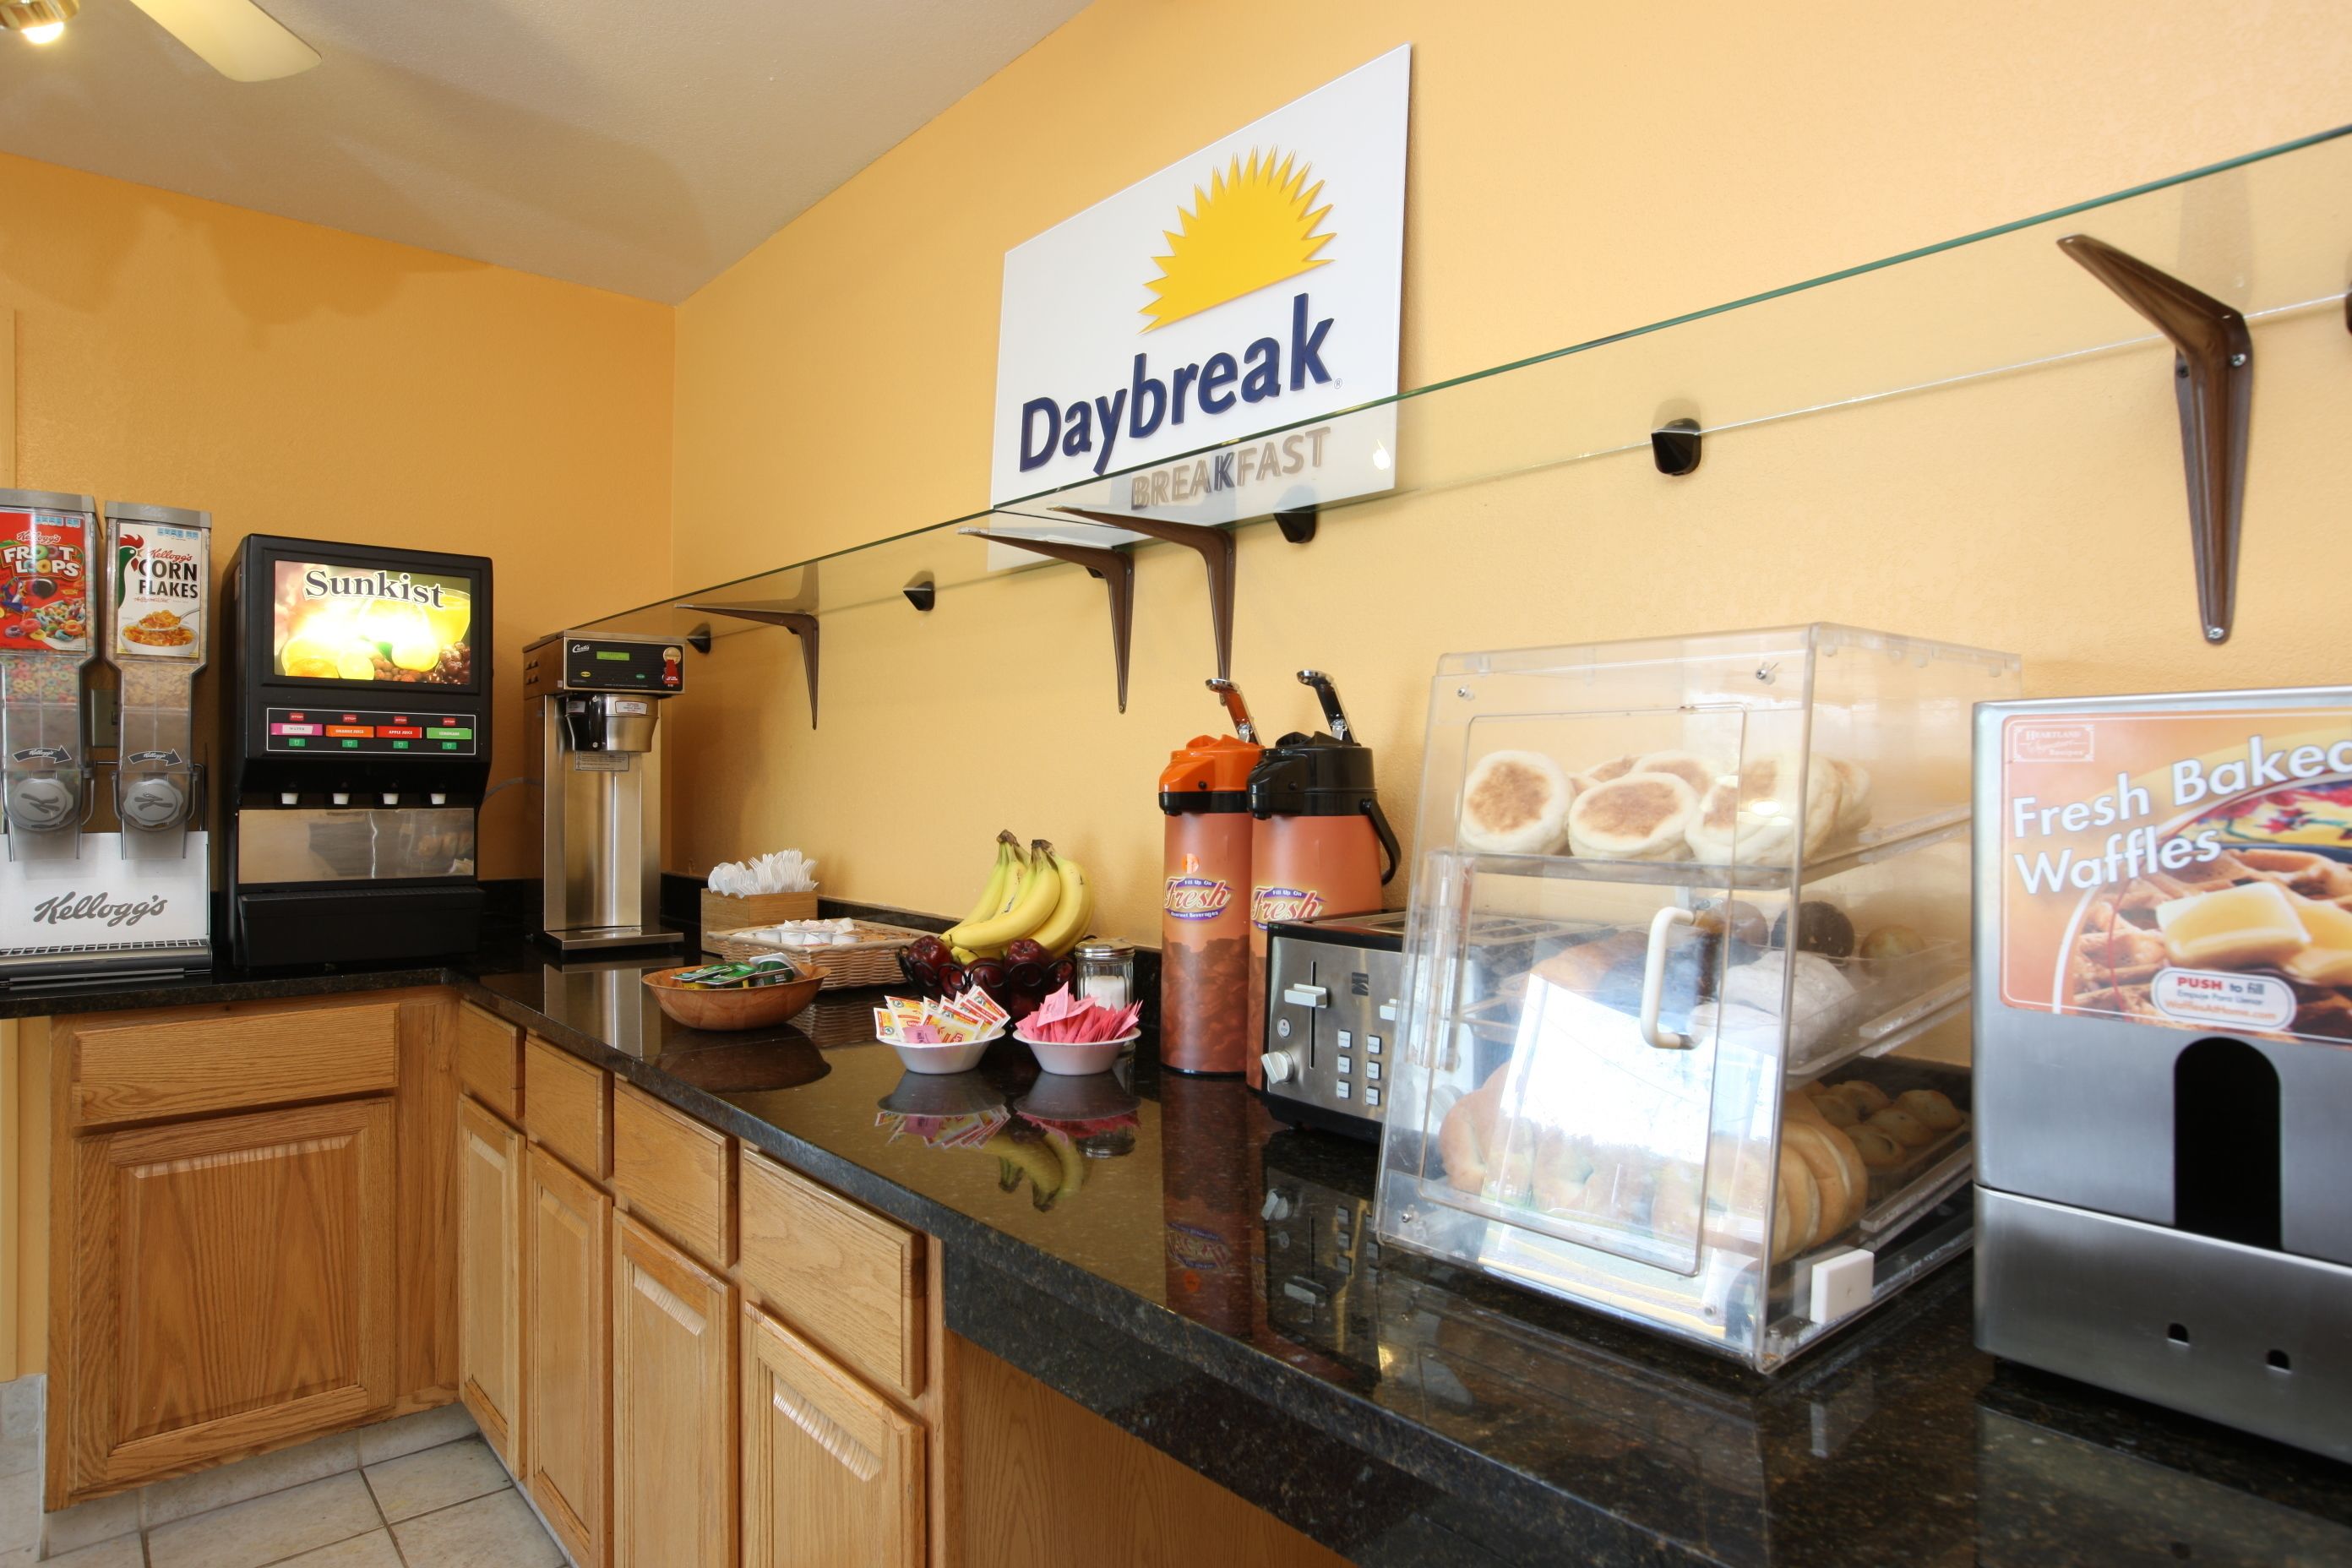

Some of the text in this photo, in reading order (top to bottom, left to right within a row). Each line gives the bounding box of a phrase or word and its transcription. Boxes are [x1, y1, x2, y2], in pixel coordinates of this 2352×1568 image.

[1019, 292, 1335, 476] Daybreak
[1130, 426, 1331, 510] BREAKFAST
[17, 530, 61, 544] Kelogg's
[3, 545, 74, 564] FROOT
[15, 559, 80, 576] LOOPS
[149, 547, 193, 564] Kellogg's
[138, 558, 198, 581] CORN
[139, 579, 199, 599] FLAKES
[303, 569, 445, 609] Sunkist
[572, 644, 590, 653] Curtis
[2012, 771, 2151, 838] Fresh
[2013, 825, 2222, 896] Waffles
[1163, 876, 1231, 909] Fresh
[1250, 885, 1323, 921] Fresh
[33, 890, 168, 928] Kellogg's
[2177, 977, 2265, 995] PUSH to fill
